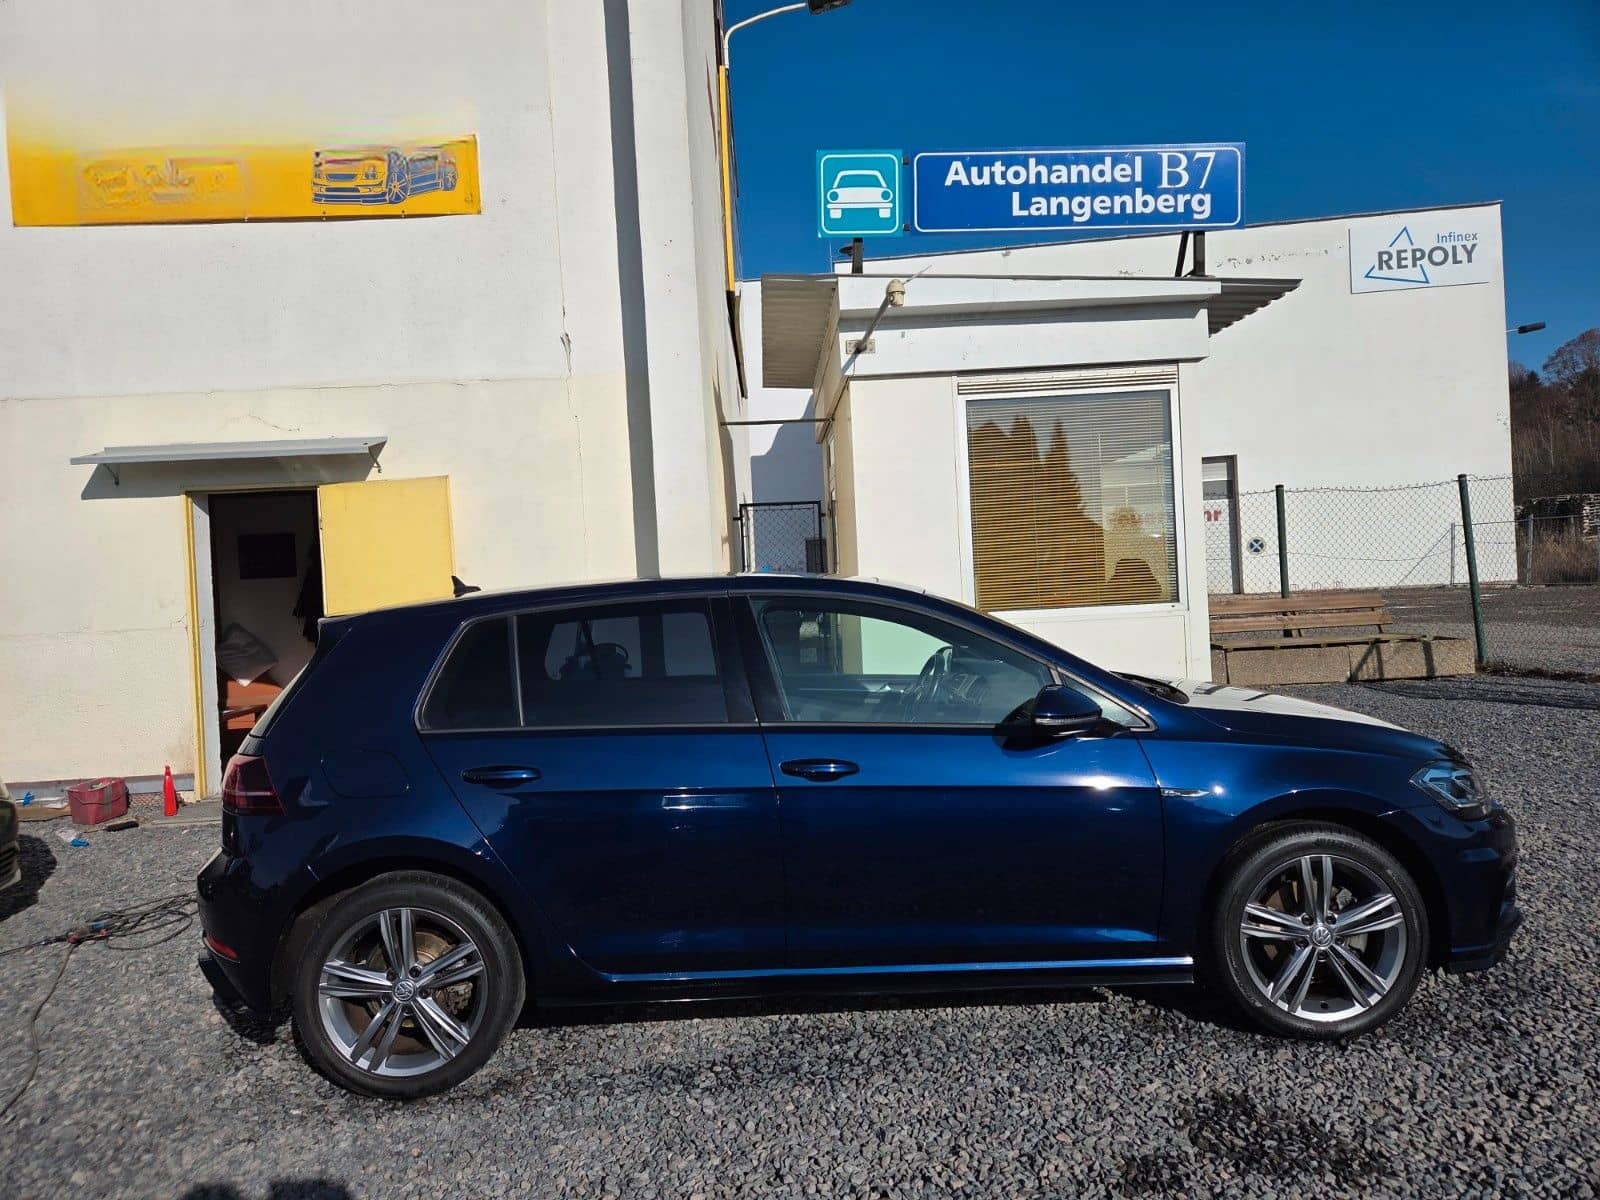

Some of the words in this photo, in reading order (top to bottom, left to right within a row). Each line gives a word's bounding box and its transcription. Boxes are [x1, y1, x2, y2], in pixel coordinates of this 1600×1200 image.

[944, 156, 1142, 186] Autohandel
[1157, 151, 1216, 189] B7
[1012, 187, 1212, 223] Langenberg
[1436, 231, 1478, 244] Infinex
[1377, 243, 1478, 271] REPOLY
